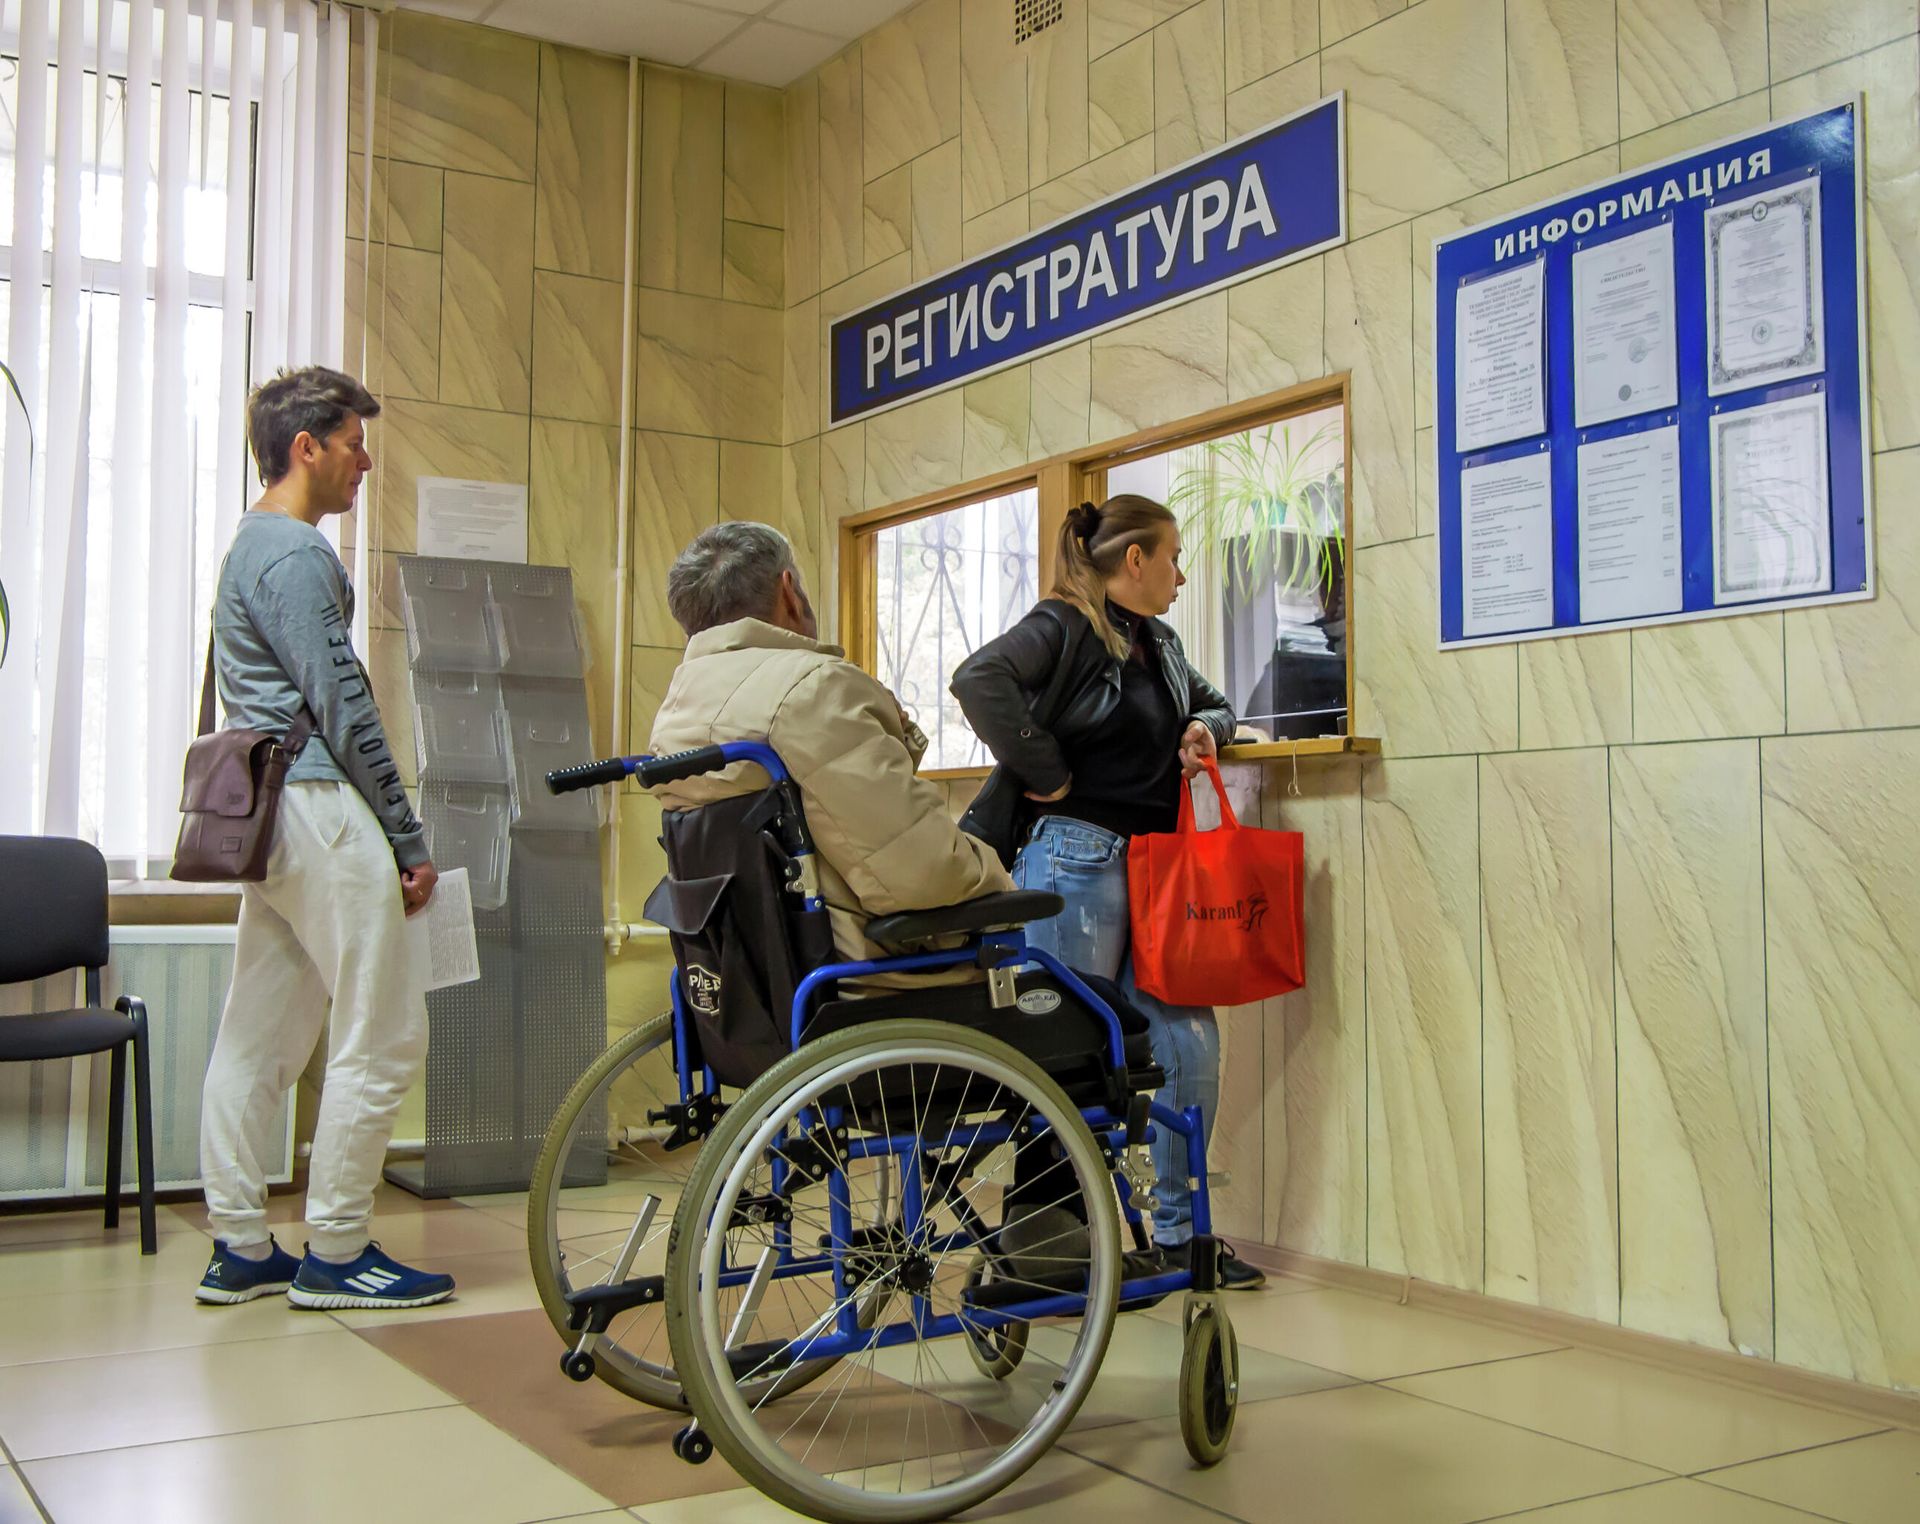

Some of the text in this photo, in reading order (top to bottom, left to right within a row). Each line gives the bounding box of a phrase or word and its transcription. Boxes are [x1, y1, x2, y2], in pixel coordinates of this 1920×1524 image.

[866, 163, 1277, 389] РЕГИСТРАТУРА
[1494, 148, 1771, 262] ИНФОРМАЦИЯ
[328, 635, 405, 808] ENJOY LIFE
